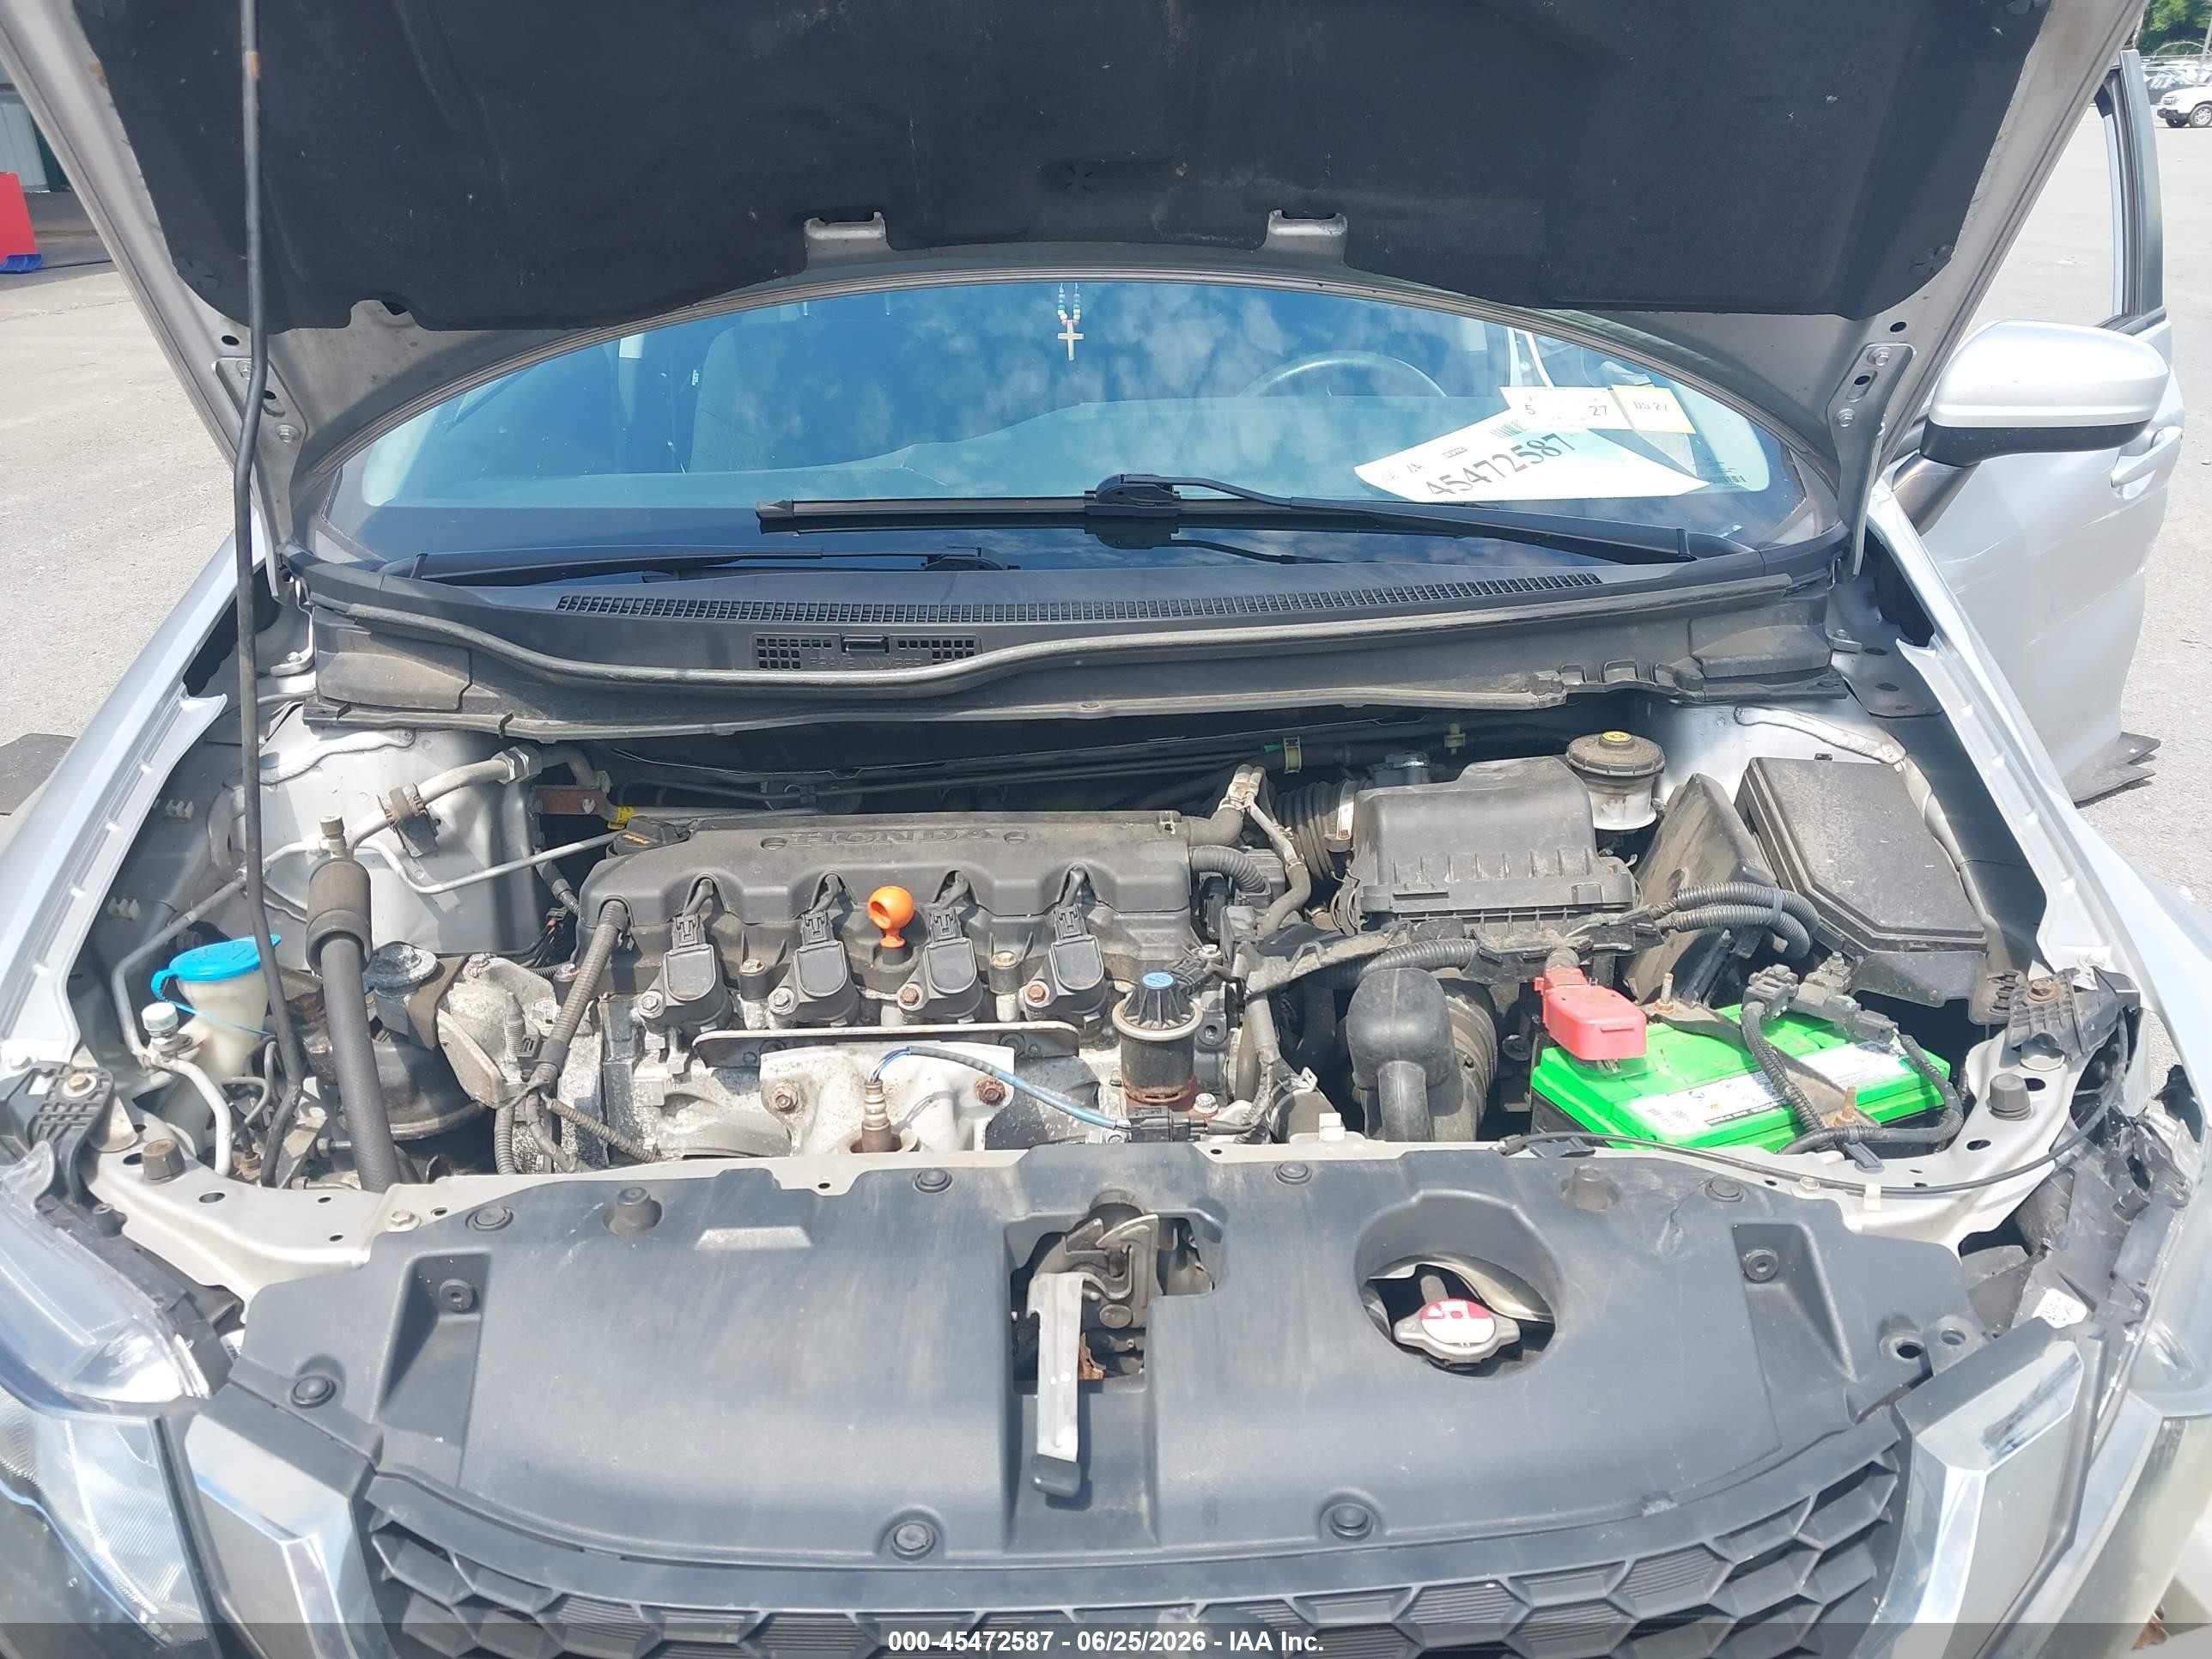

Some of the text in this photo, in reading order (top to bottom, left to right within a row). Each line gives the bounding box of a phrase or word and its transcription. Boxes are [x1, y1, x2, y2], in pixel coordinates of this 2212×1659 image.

[1524, 404, 1608, 416] 5 27
[1425, 433, 1576, 495] 45472587
[791, 829, 998, 847] HONDA
